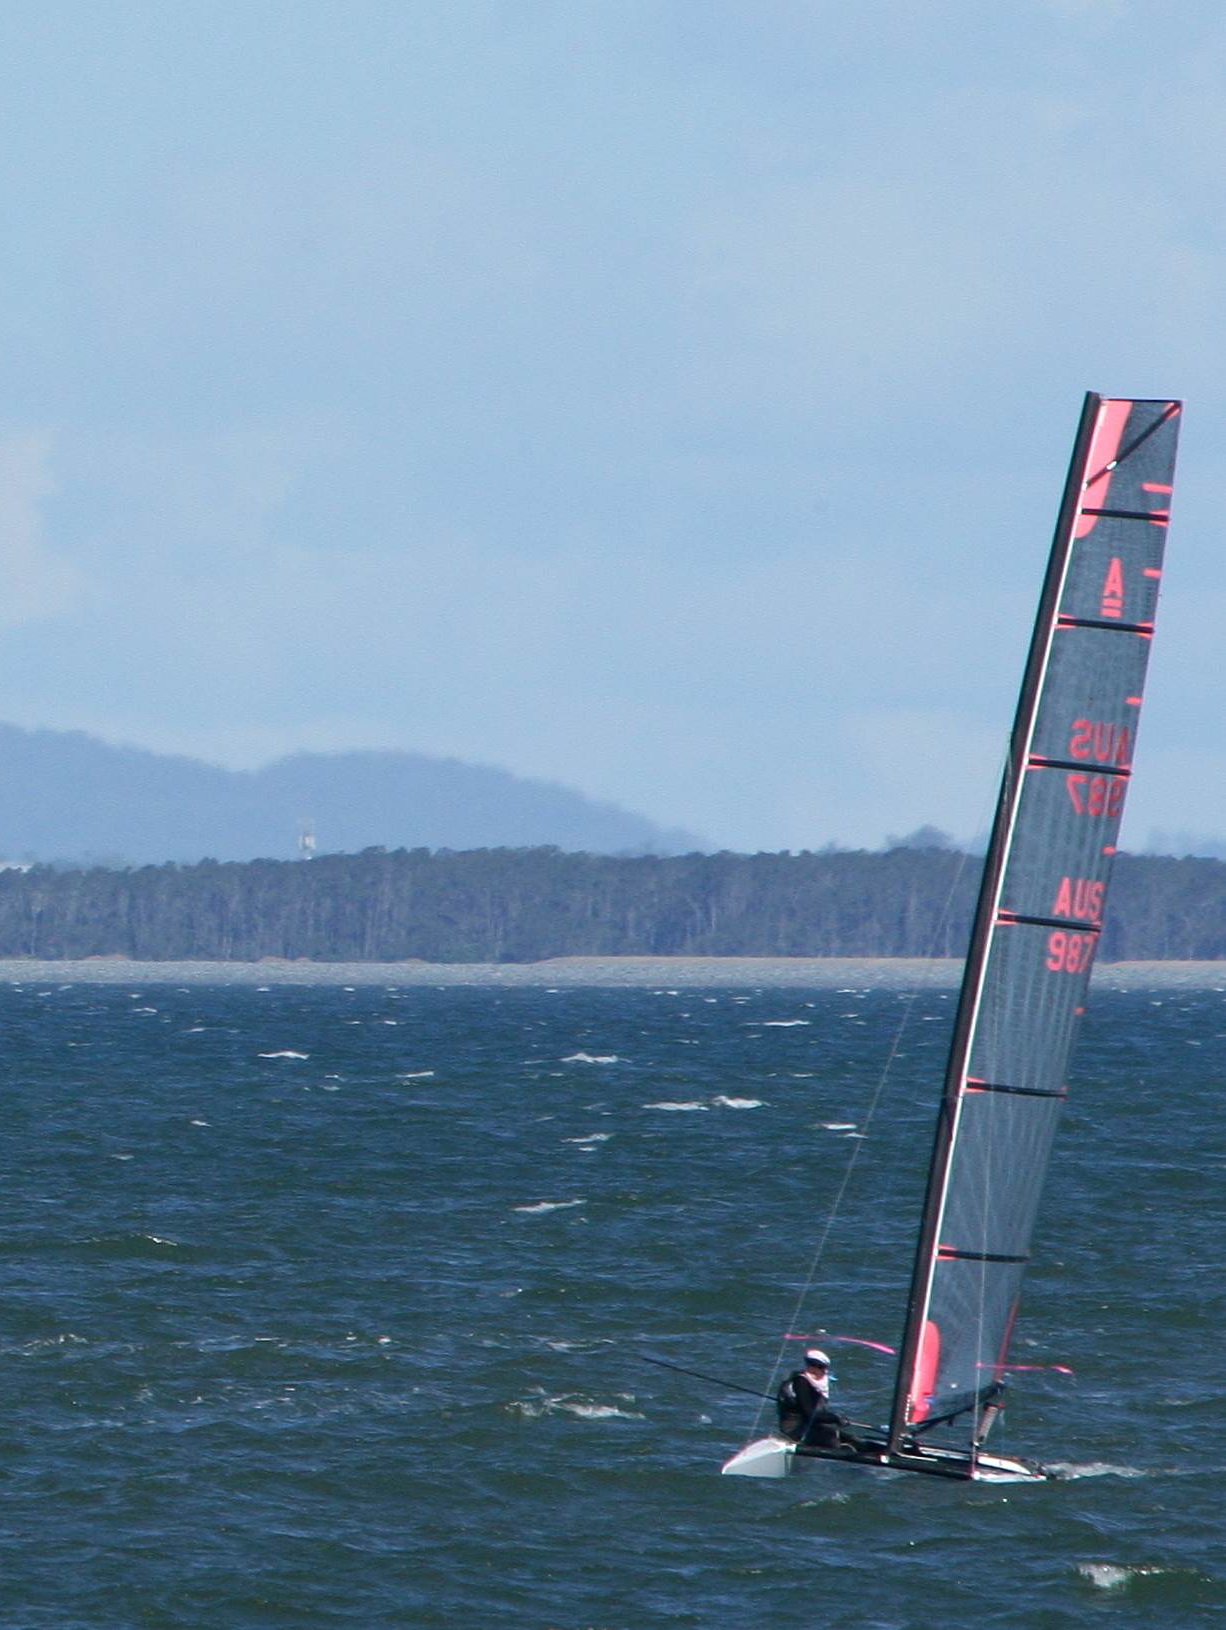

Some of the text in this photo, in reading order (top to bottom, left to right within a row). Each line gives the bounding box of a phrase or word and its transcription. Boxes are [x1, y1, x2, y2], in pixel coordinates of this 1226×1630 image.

[1102, 557, 1126, 597] A
[1053, 876, 1105, 920] AUS
[1045, 932, 1097, 973] 987
